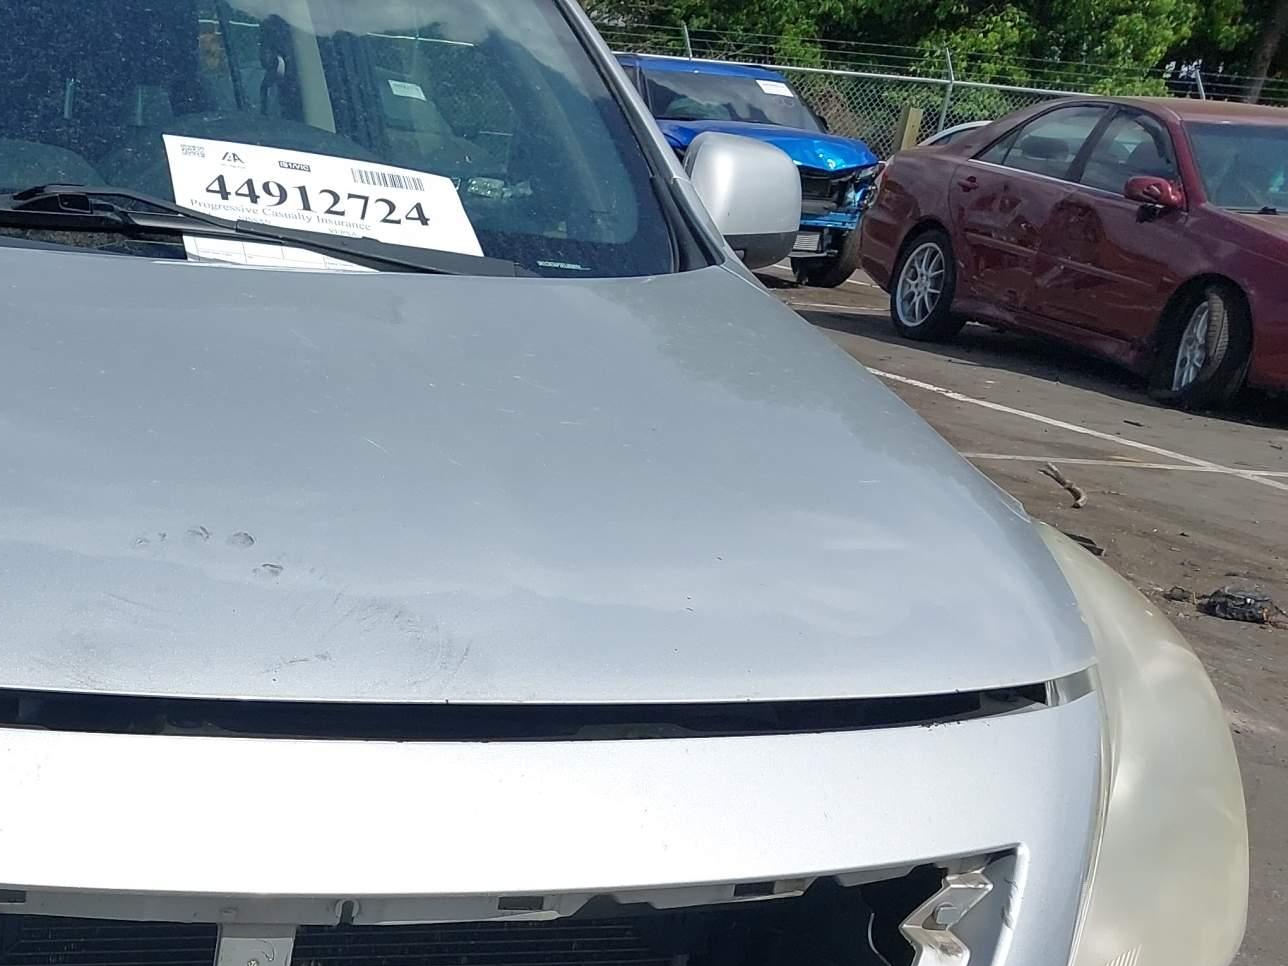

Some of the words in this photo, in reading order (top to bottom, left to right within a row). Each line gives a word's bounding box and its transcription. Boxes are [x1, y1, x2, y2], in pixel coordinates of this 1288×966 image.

[190, 199, 259, 215] Progressive
[262, 207, 313, 223] Casualty
[316, 215, 372, 231] Insurance
[205, 174, 431, 227] 44912724
